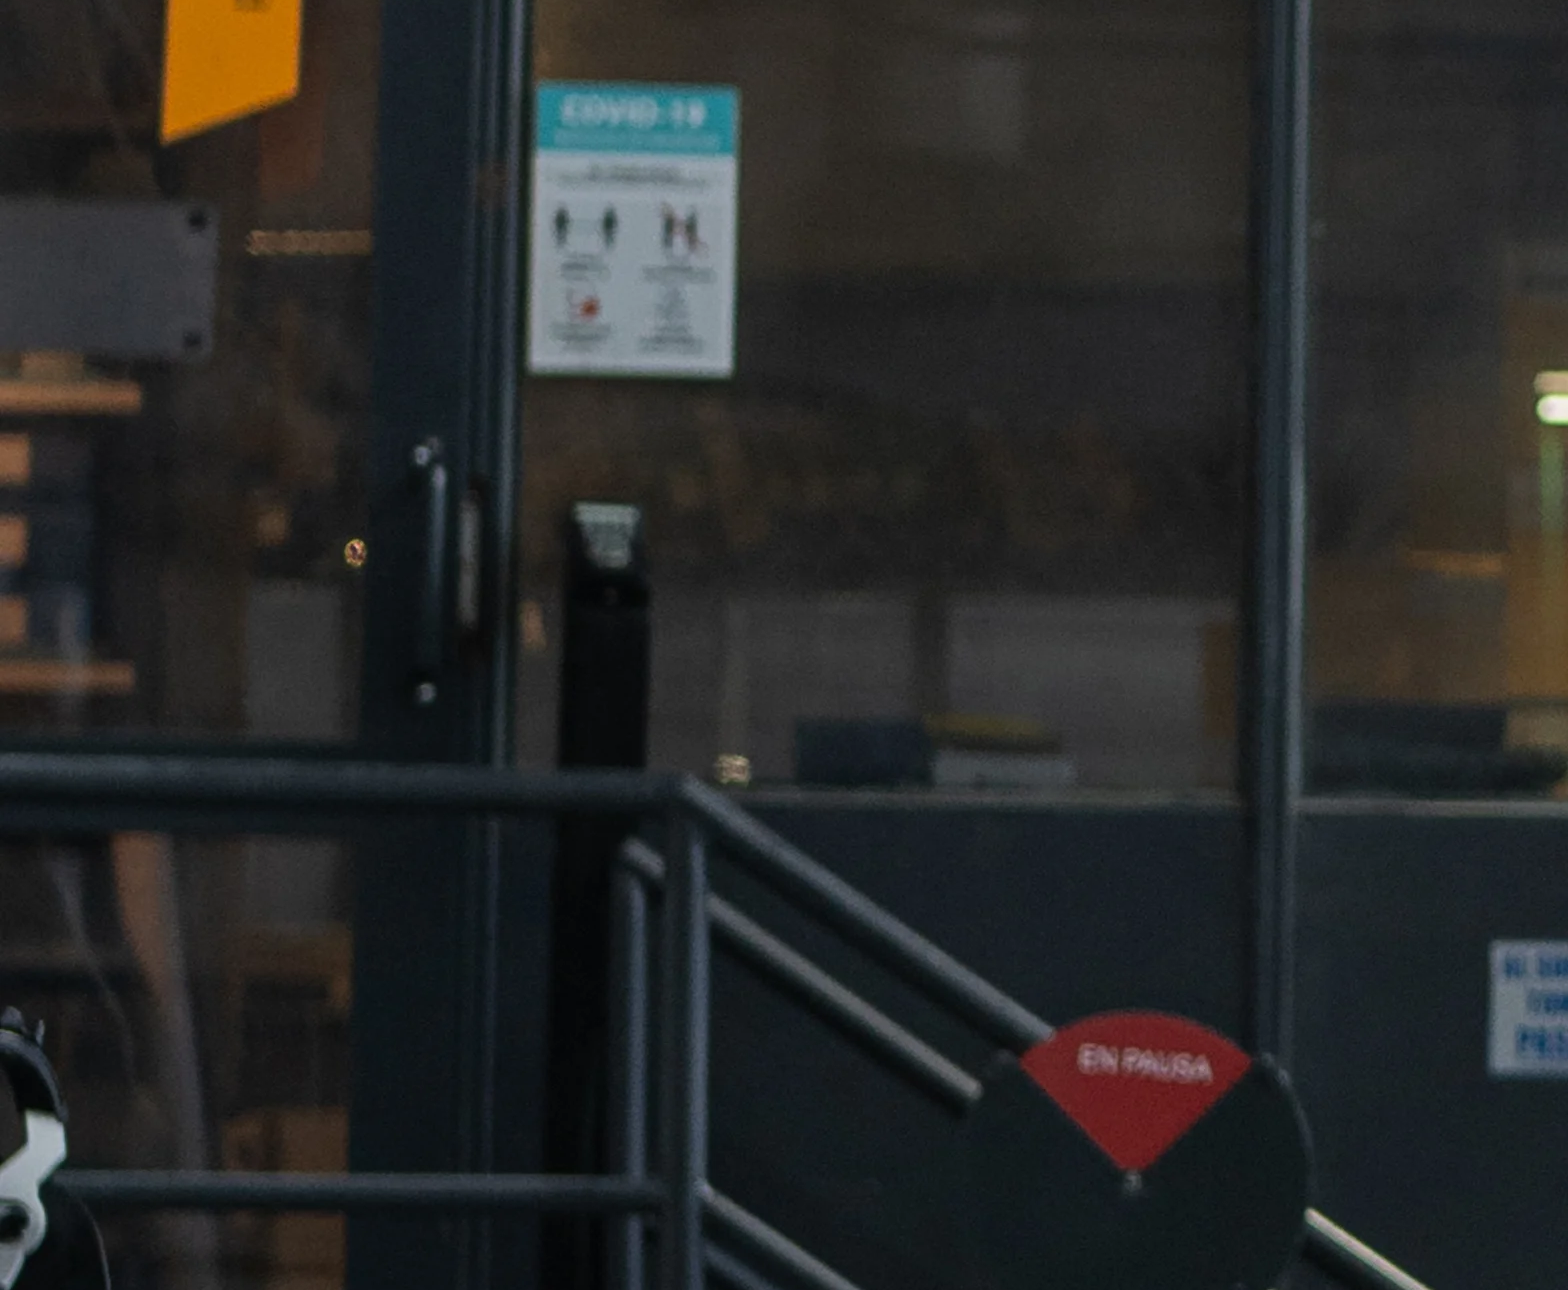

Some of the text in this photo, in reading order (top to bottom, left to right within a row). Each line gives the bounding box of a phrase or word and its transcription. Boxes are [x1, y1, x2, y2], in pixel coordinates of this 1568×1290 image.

[560, 93, 707, 129] COVID-19
[1077, 1043, 1213, 1084] EN PAUSA
